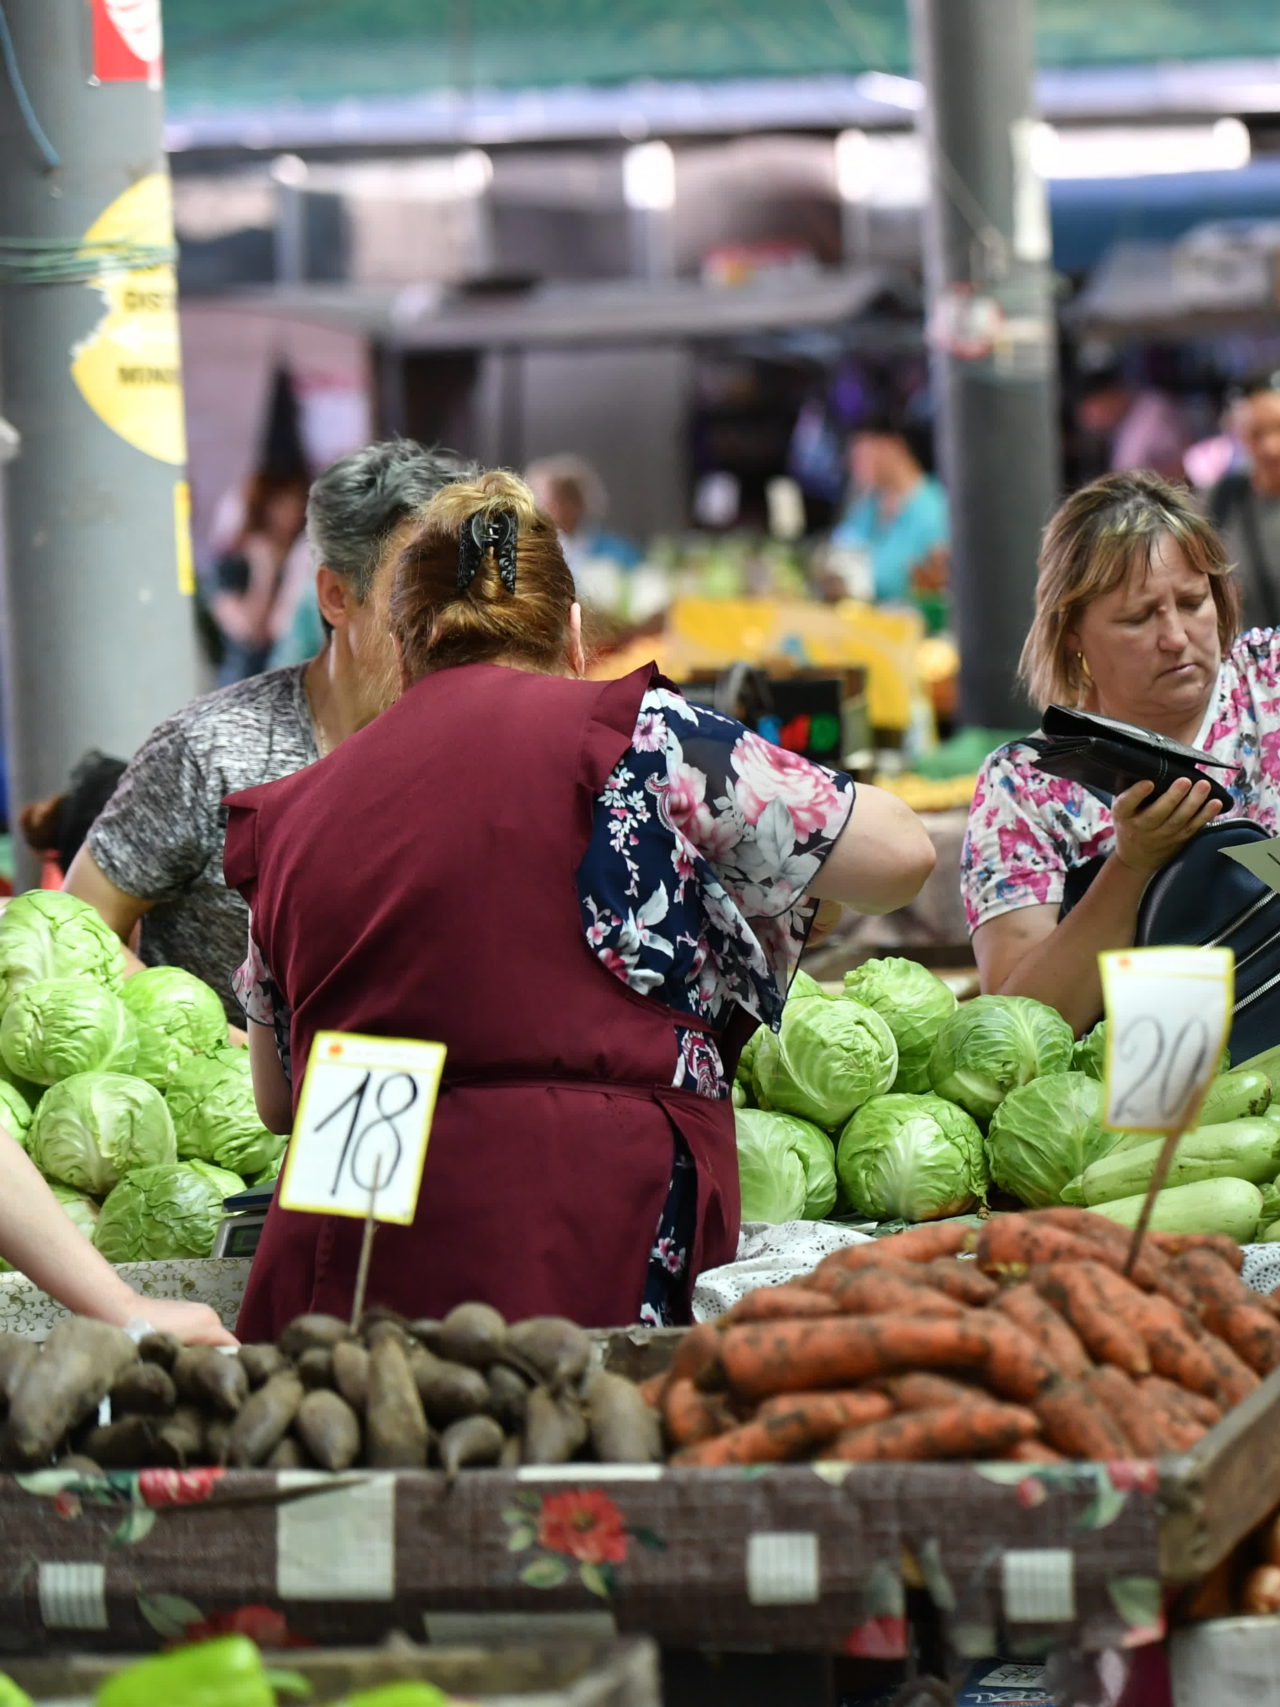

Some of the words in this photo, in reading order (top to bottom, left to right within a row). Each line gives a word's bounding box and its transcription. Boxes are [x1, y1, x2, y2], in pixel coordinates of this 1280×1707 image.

[123, 291, 172, 312] DIS
[1113, 1013, 1210, 1122] 20
[313, 1070, 418, 1197] 18
